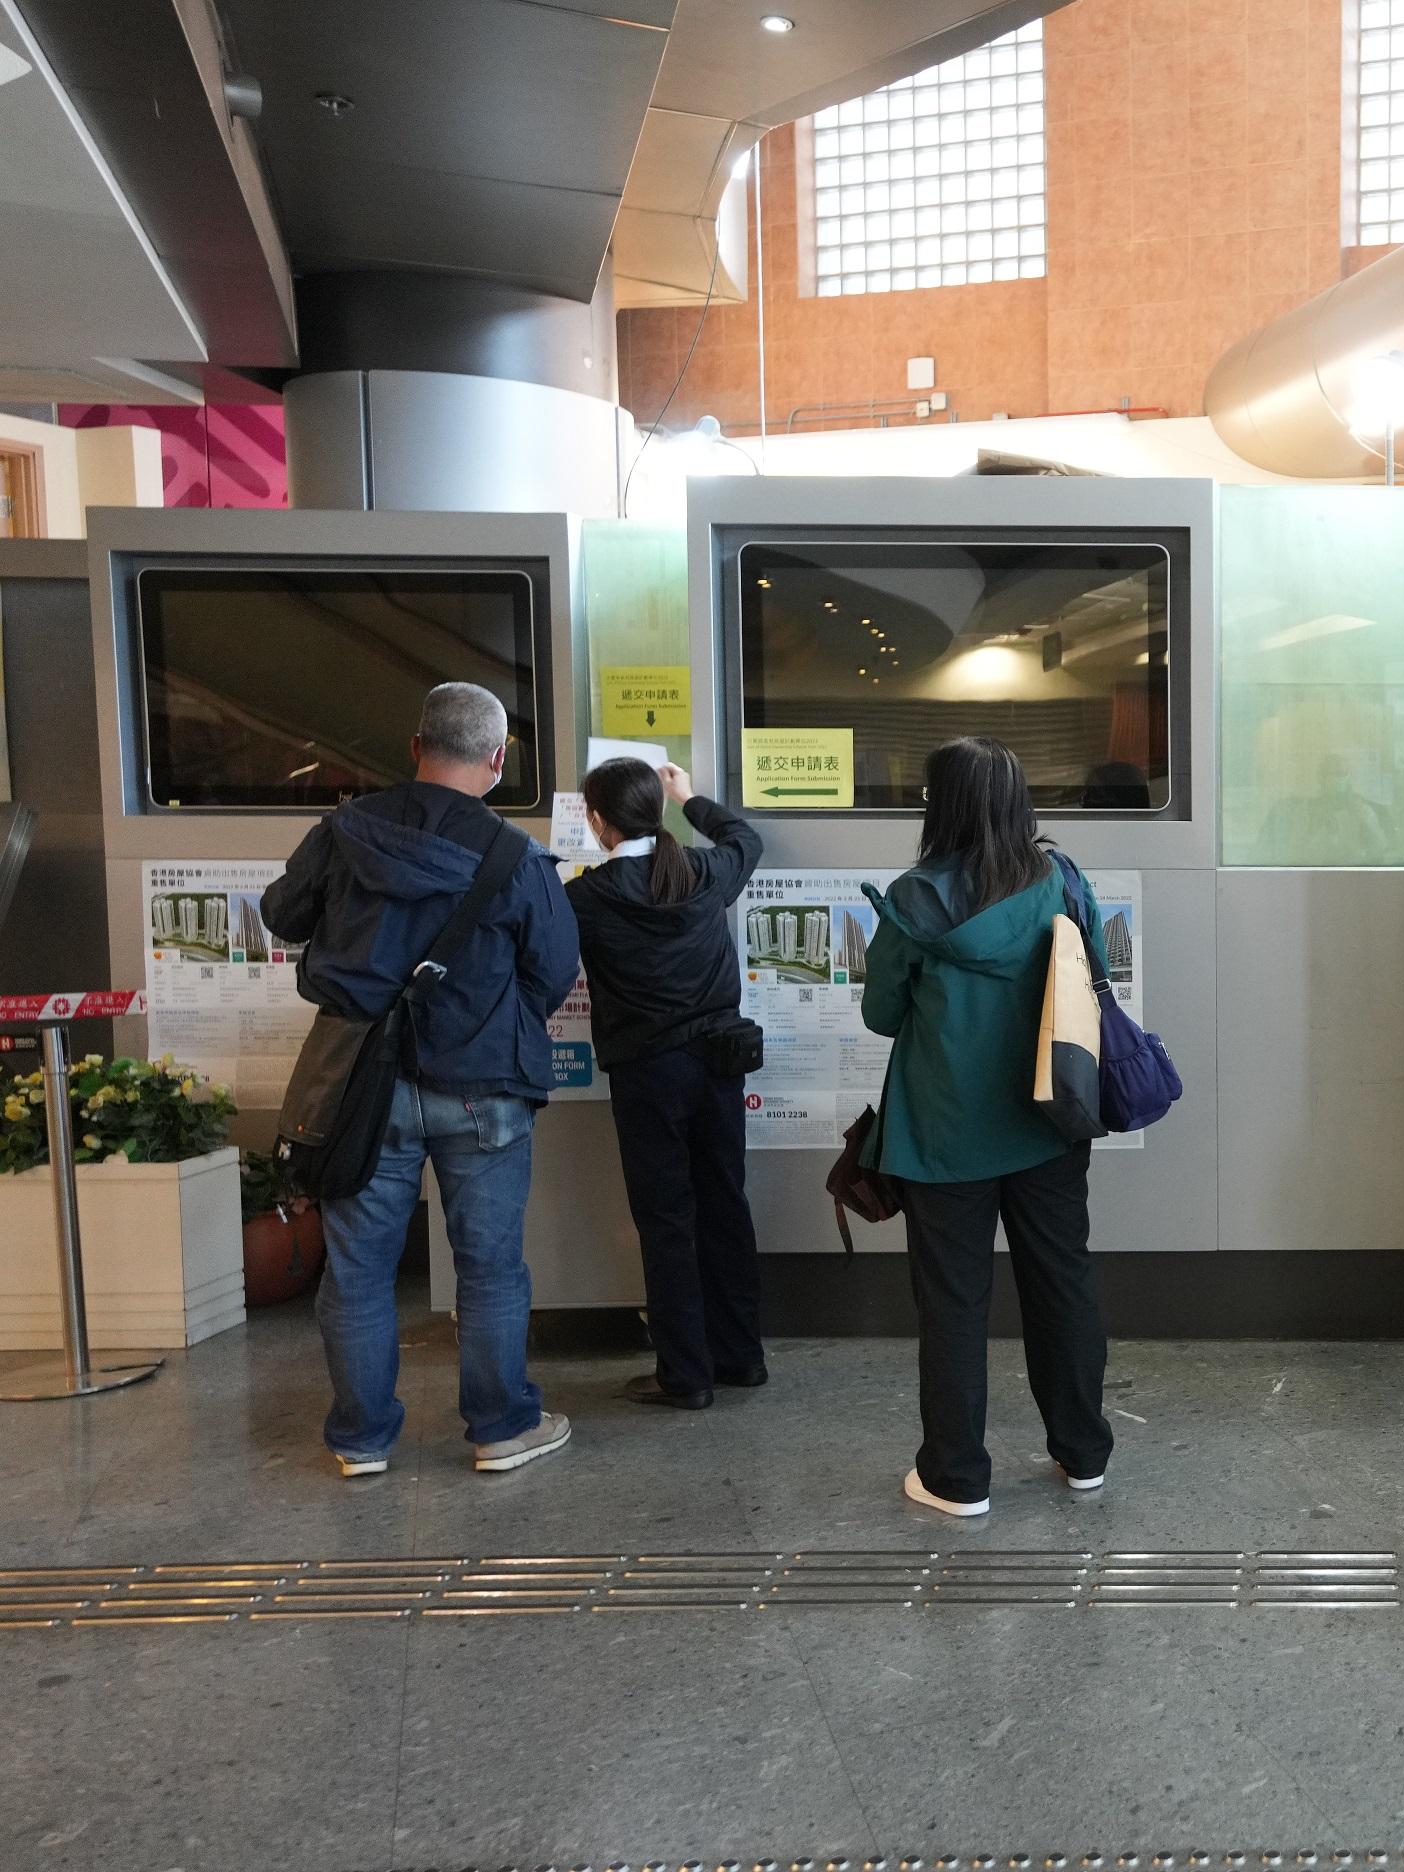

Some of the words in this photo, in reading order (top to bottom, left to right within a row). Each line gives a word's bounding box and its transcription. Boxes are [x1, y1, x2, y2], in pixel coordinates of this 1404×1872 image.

[757, 756, 839, 771] 遞交申請表
[14, 1010, 39, 1019] ENTRY
[549, 1025, 563, 1037] 22
[564, 1061, 585, 1070] FORM
